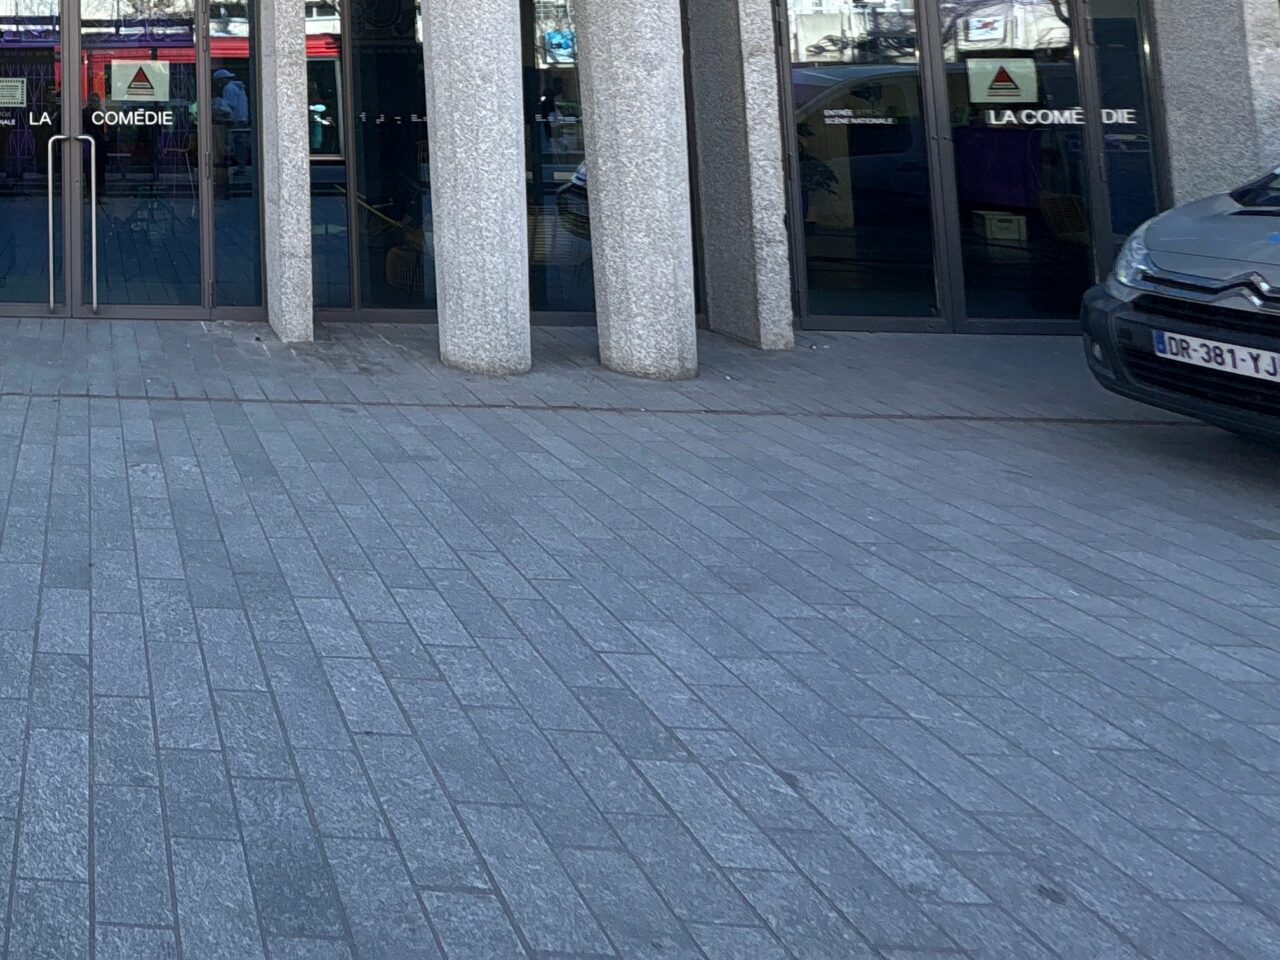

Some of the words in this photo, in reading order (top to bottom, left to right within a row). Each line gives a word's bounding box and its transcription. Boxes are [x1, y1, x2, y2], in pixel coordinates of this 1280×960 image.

[29, 112, 52, 125] LA
[91, 109, 173, 125] COMÉDIE
[990, 110, 1018, 124] LA
[1168, 336, 1279, 376] DR-381-YJ
